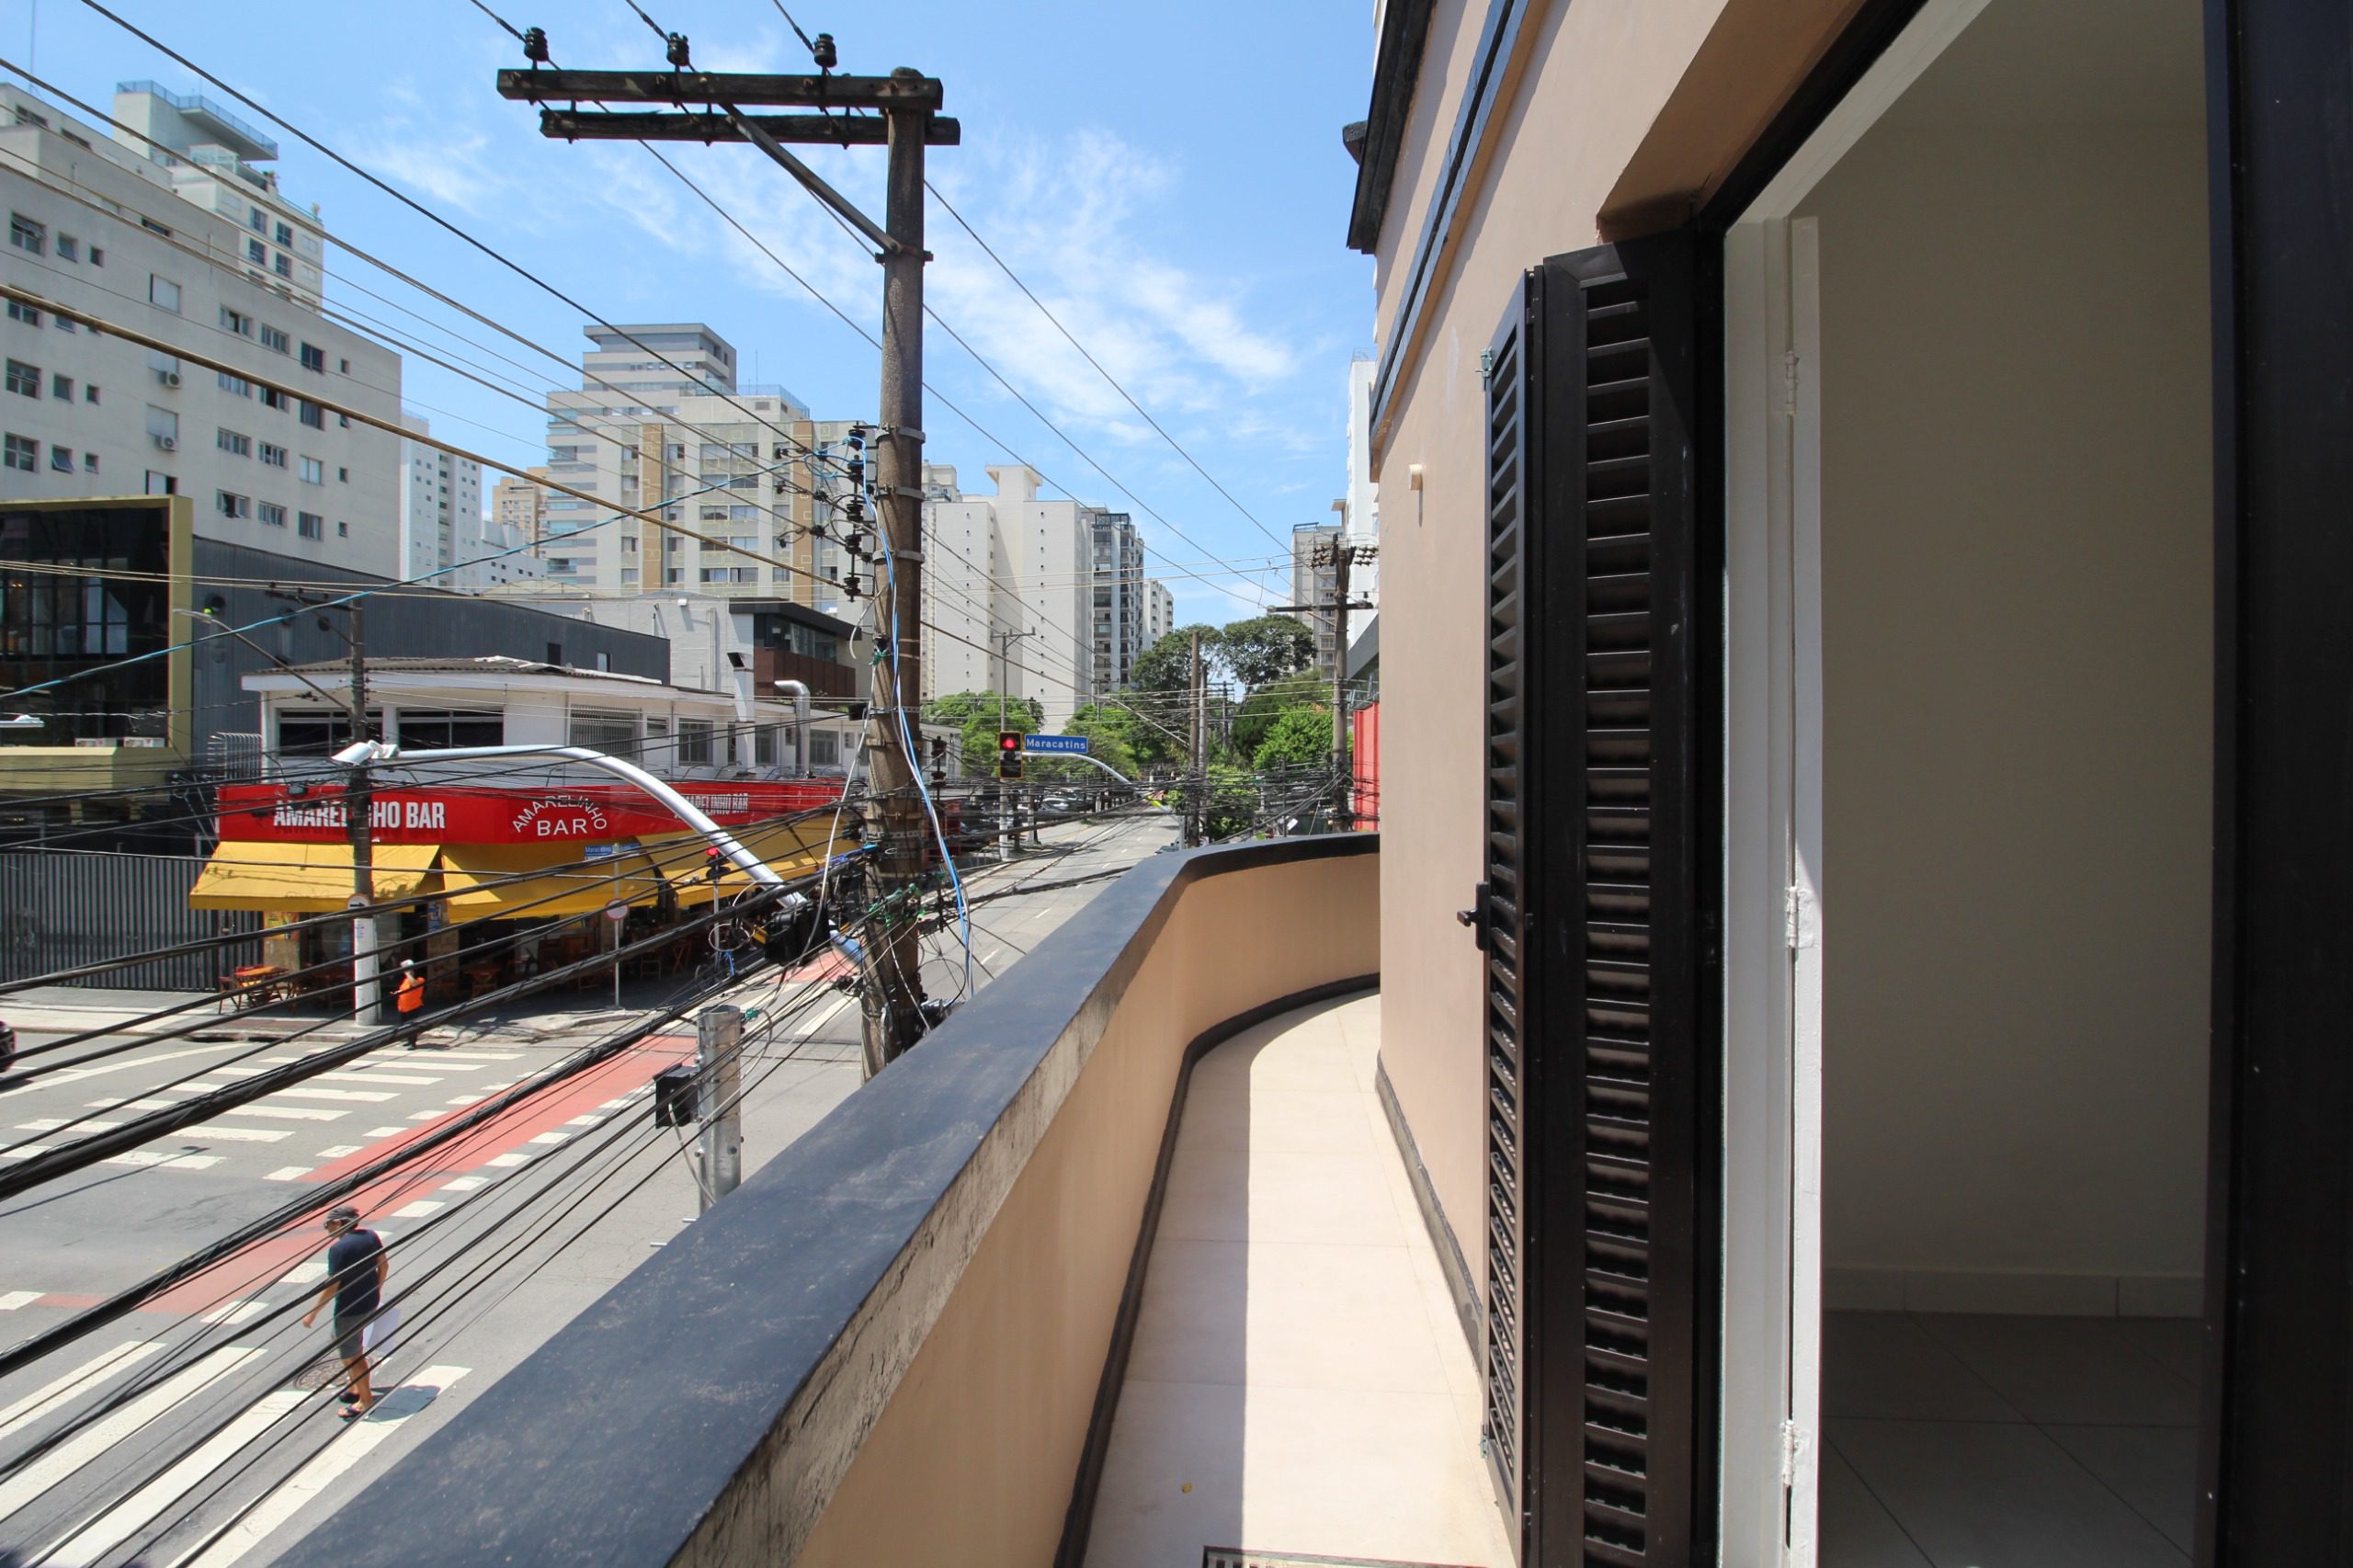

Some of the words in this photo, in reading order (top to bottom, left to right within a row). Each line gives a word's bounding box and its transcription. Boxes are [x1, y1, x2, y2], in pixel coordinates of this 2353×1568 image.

[1026, 738, 1086, 750] Maracatins
[273, 800, 401, 828] AMARELHO
[405, 801, 446, 828] BAR
[537, 818, 588, 836] BAR
